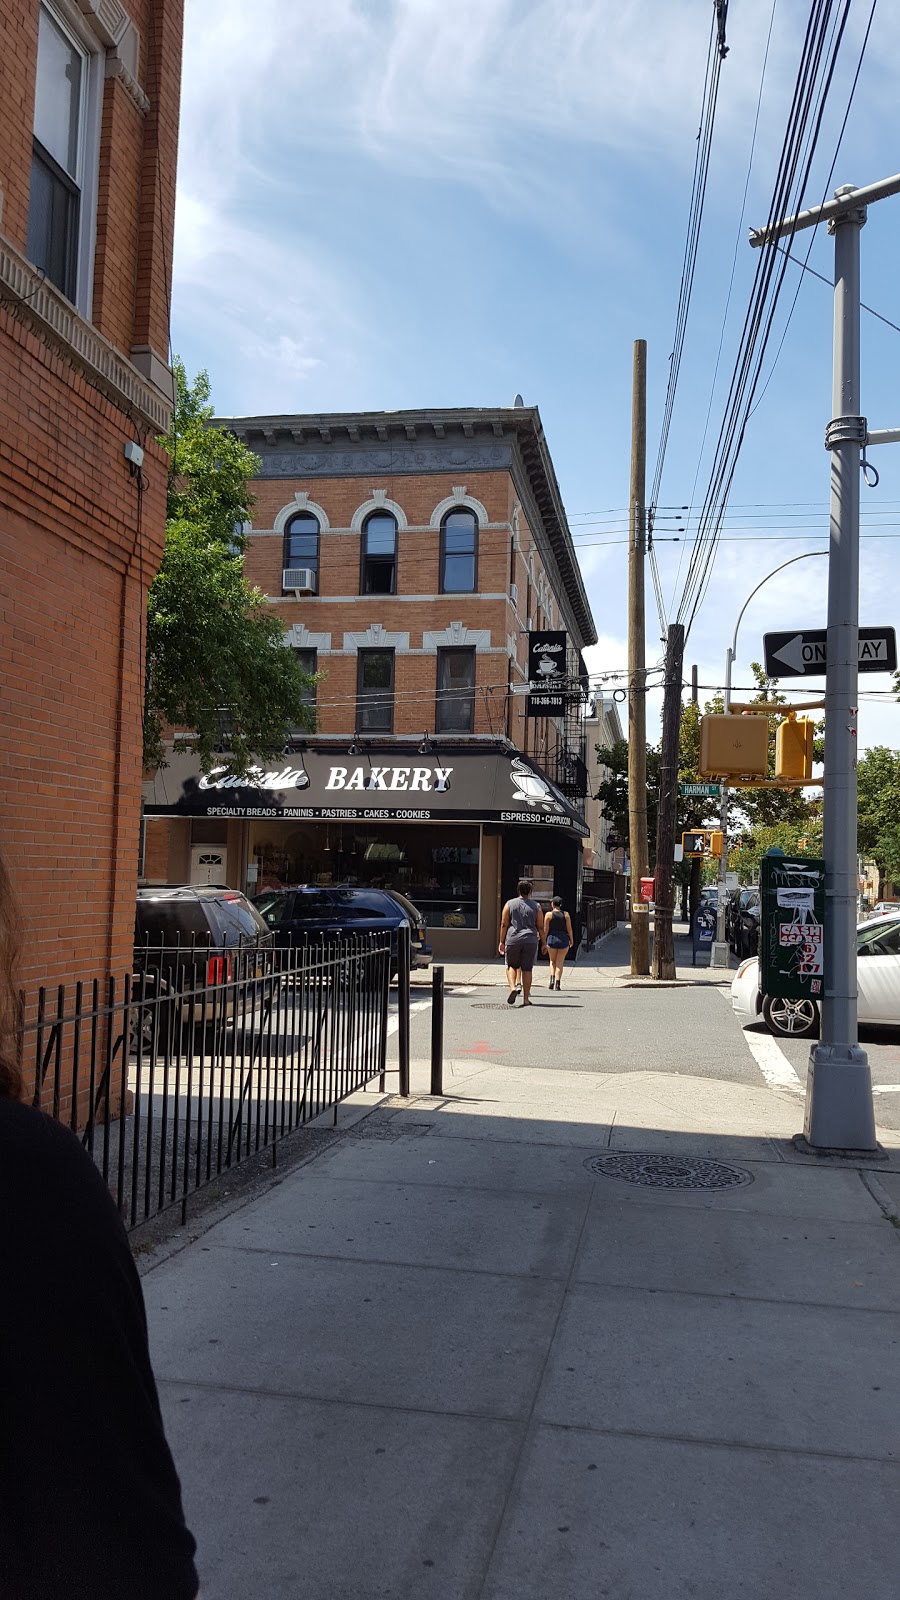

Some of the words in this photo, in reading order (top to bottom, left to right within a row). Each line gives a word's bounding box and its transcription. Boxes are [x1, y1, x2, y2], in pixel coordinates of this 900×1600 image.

[802, 644, 827, 662] ON
[858, 642, 882, 659] AY
[325, 767, 453, 791] BAKERY
[684, 786, 709, 794] HARMAN
[207, 807, 245, 816] SPECIALTY
[247, 808, 277, 816] BREADS
[283, 809, 314, 817] PANINIS
[321, 809, 357, 818] PASTRIES
[364, 809, 389, 818] CAKES
[396, 810, 430, 819] COOKIES
[500, 812, 541, 823] ESPRESSO
[781, 926, 820, 935] CASH
[781, 935, 819, 943] 4CARS
